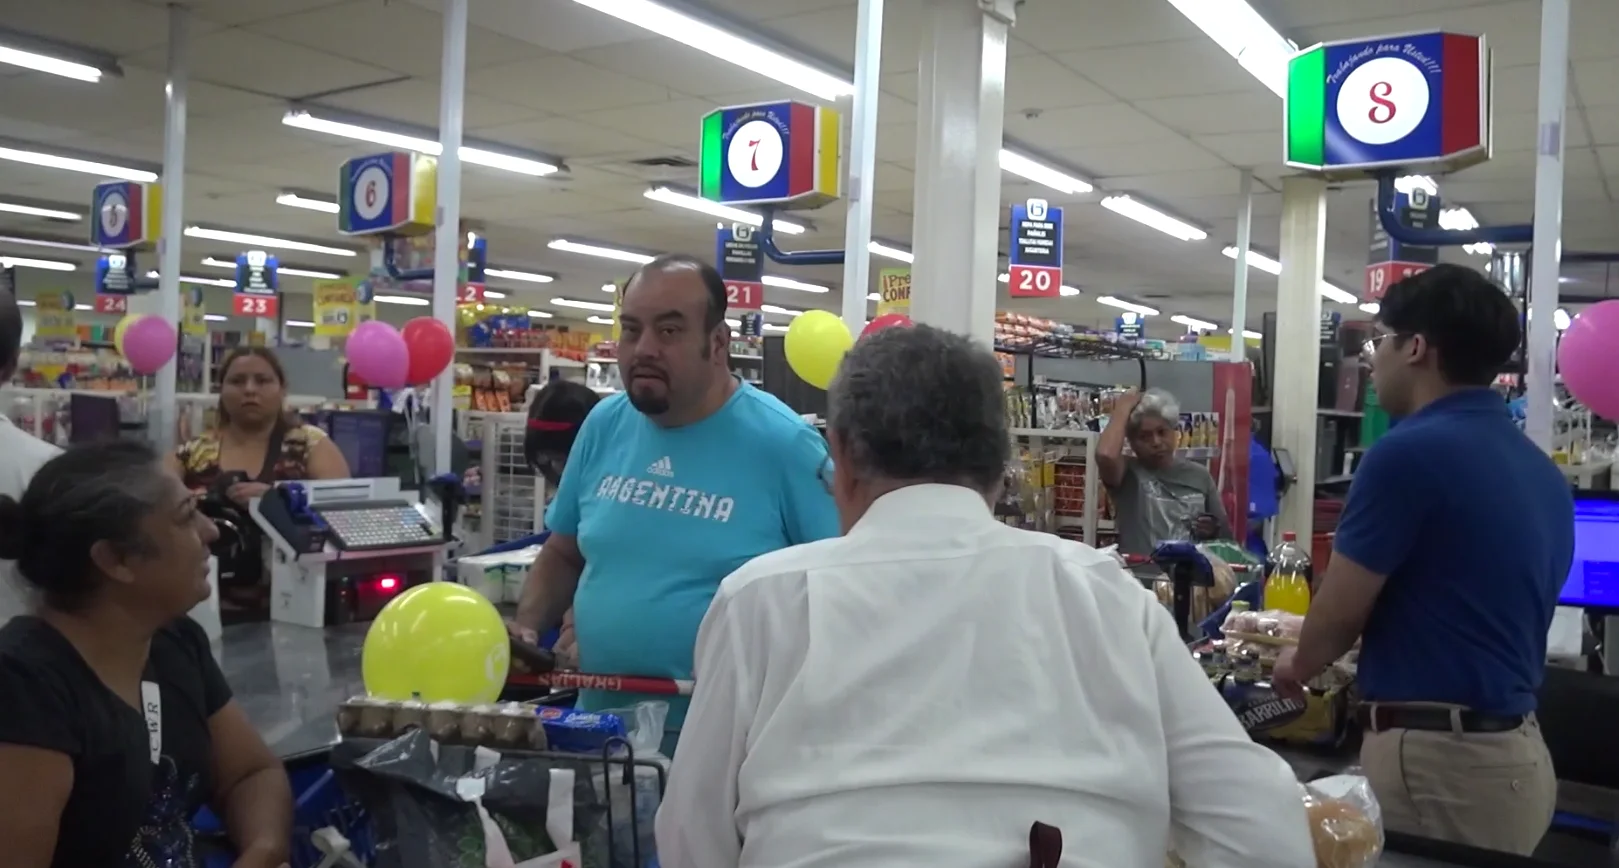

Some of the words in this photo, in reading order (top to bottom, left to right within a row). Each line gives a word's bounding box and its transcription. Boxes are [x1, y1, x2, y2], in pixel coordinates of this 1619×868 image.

[1326, 45, 1373, 84] Trabajando
[1375, 43, 1401, 55] para
[748, 139, 762, 171] 7
[365, 180, 377, 207] 6
[1019, 269, 1051, 291] 20
[1369, 268, 1385, 293] 19
[103, 298, 125, 311] 24
[242, 298, 267, 313] 23
[727, 285, 751, 304] 21
[597, 475, 735, 522] ARGENTINA
